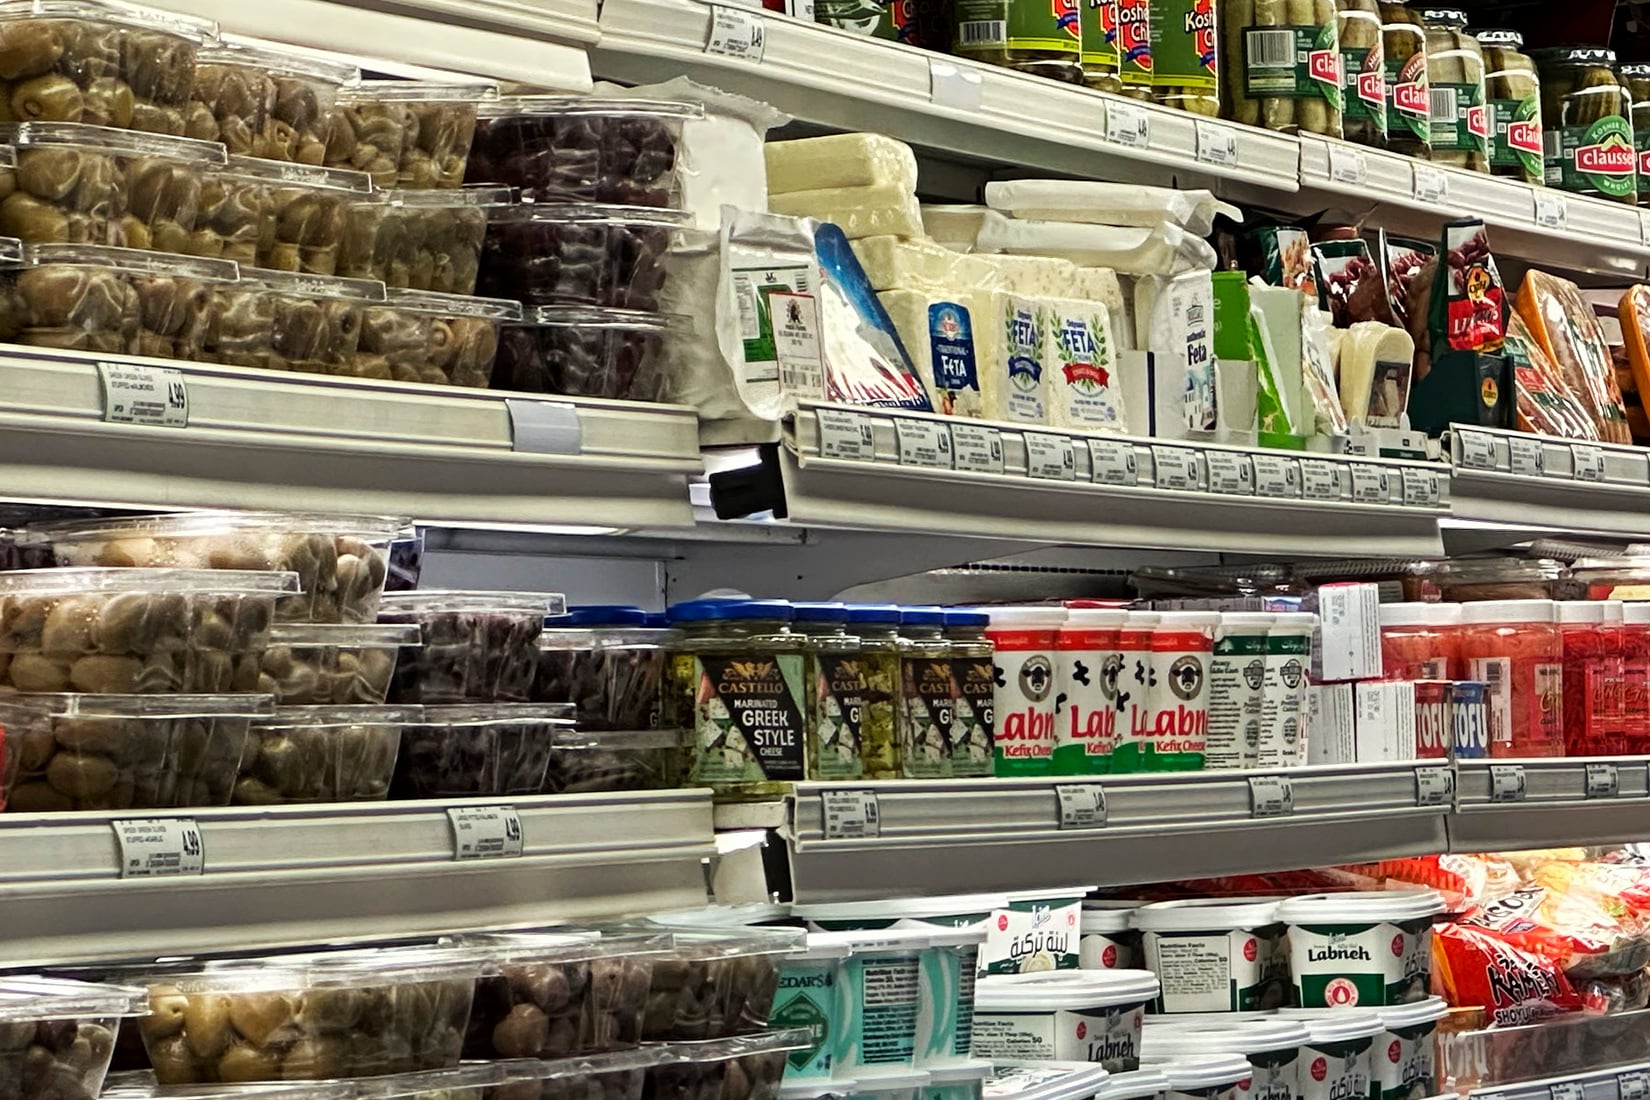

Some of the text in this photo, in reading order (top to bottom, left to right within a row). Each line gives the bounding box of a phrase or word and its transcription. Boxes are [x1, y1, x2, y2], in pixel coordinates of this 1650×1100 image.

[1013, 319, 1036, 346] FETA
[1063, 327, 1096, 353] FETA
[941, 355, 968, 378] FETA
[1188, 344, 1208, 367] Feta
[168, 382, 185, 409] 4.99
[718, 681, 784, 695] CASTELLO
[742, 710, 790, 728] GREEK
[1415, 702, 1449, 749] TOFU
[1452, 702, 1489, 749] TOFU
[753, 729, 796, 747] STYLE
[505, 816, 521, 842] 4.99
[181, 830, 200, 856] 4.99
[1307, 945, 1372, 963] Labneh
[1495, 1005, 1530, 1024] SHOYU
[1088, 1032, 1135, 1062] Labneh
